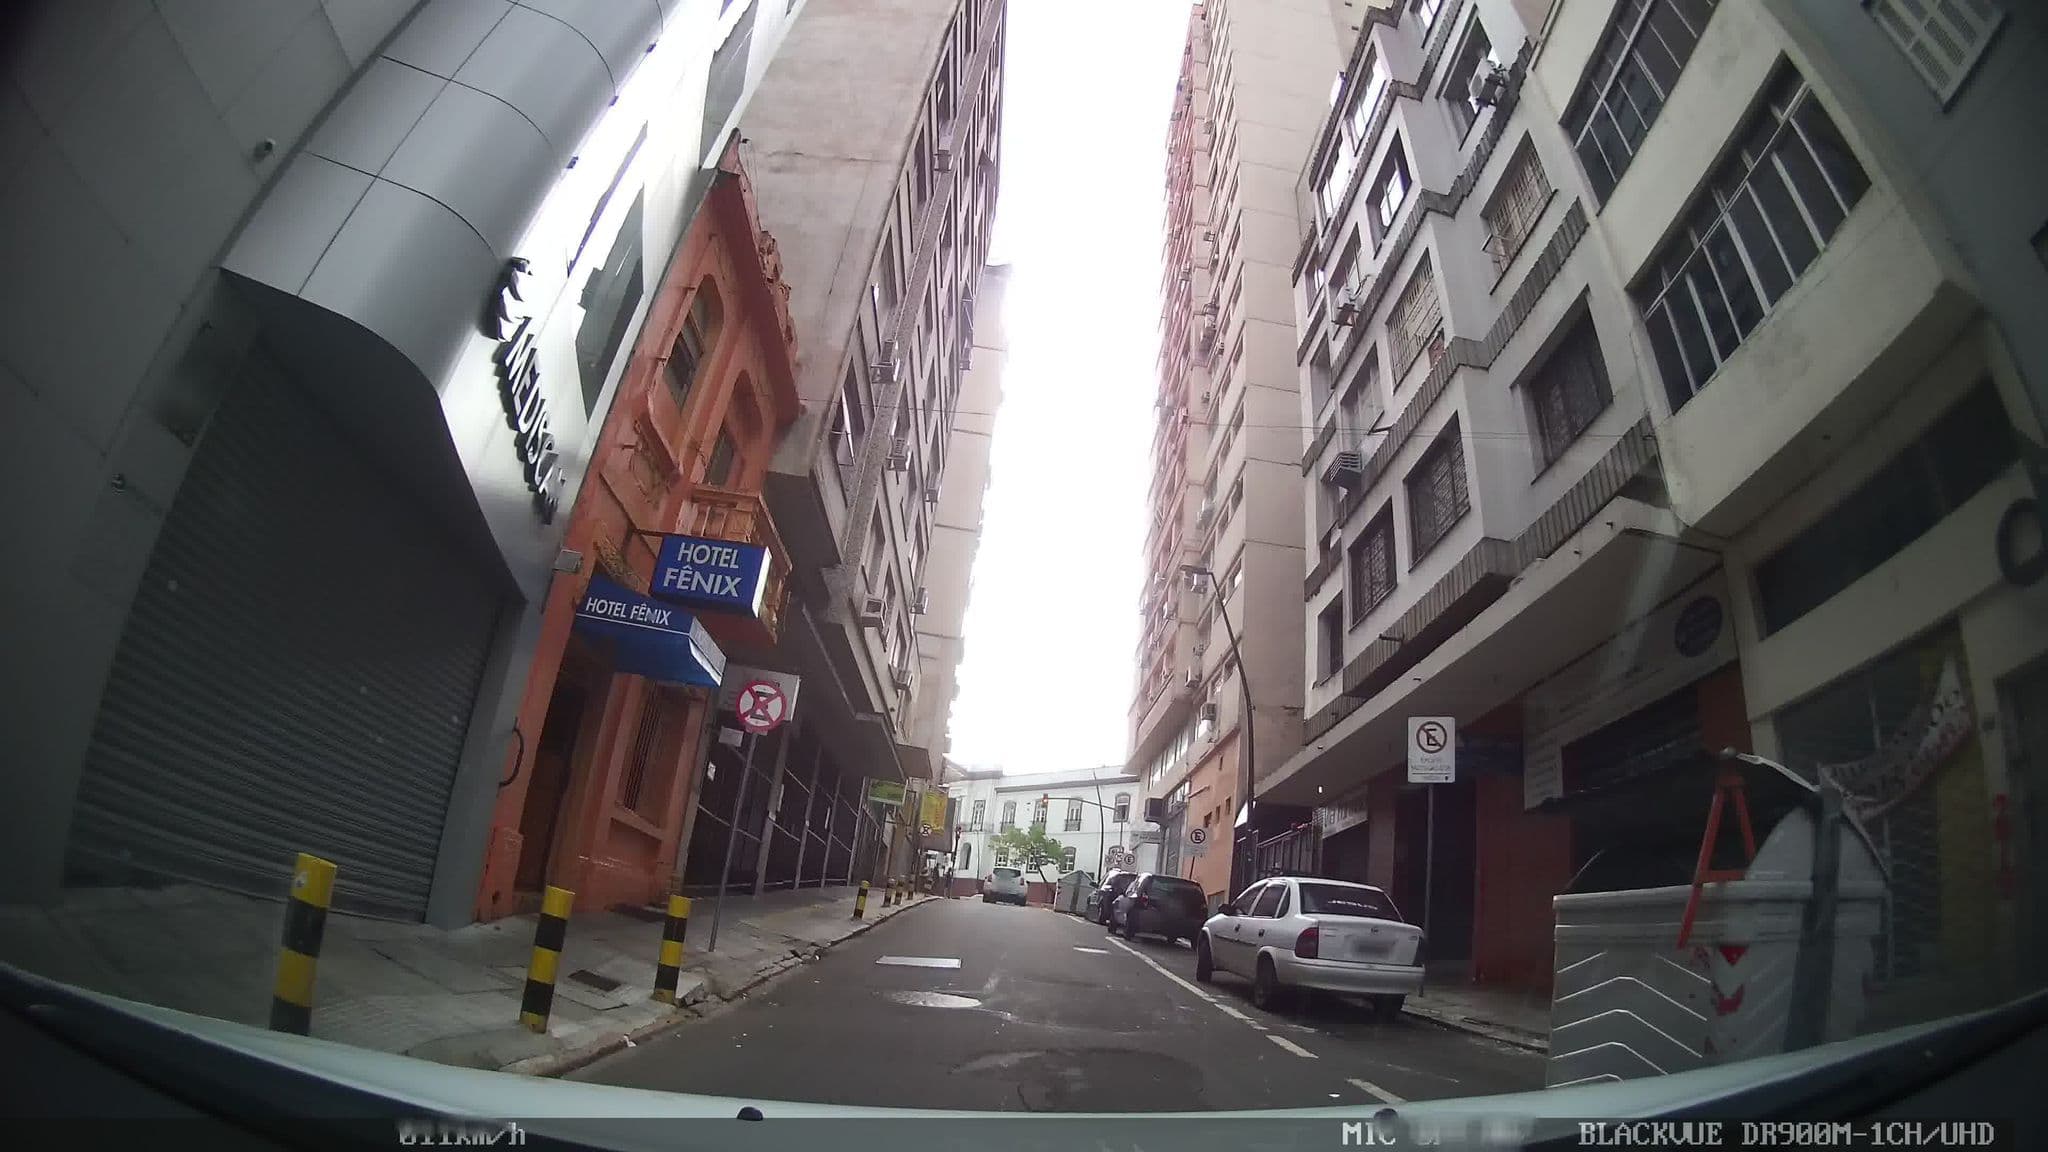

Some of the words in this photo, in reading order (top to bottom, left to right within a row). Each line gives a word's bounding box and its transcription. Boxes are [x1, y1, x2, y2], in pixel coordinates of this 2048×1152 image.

[677, 542, 739, 569] HOTEL
[663, 565, 742, 598] FÊNIX
[585, 597, 627, 619] HOTEL
[630, 601, 672, 626] FÊNIX
